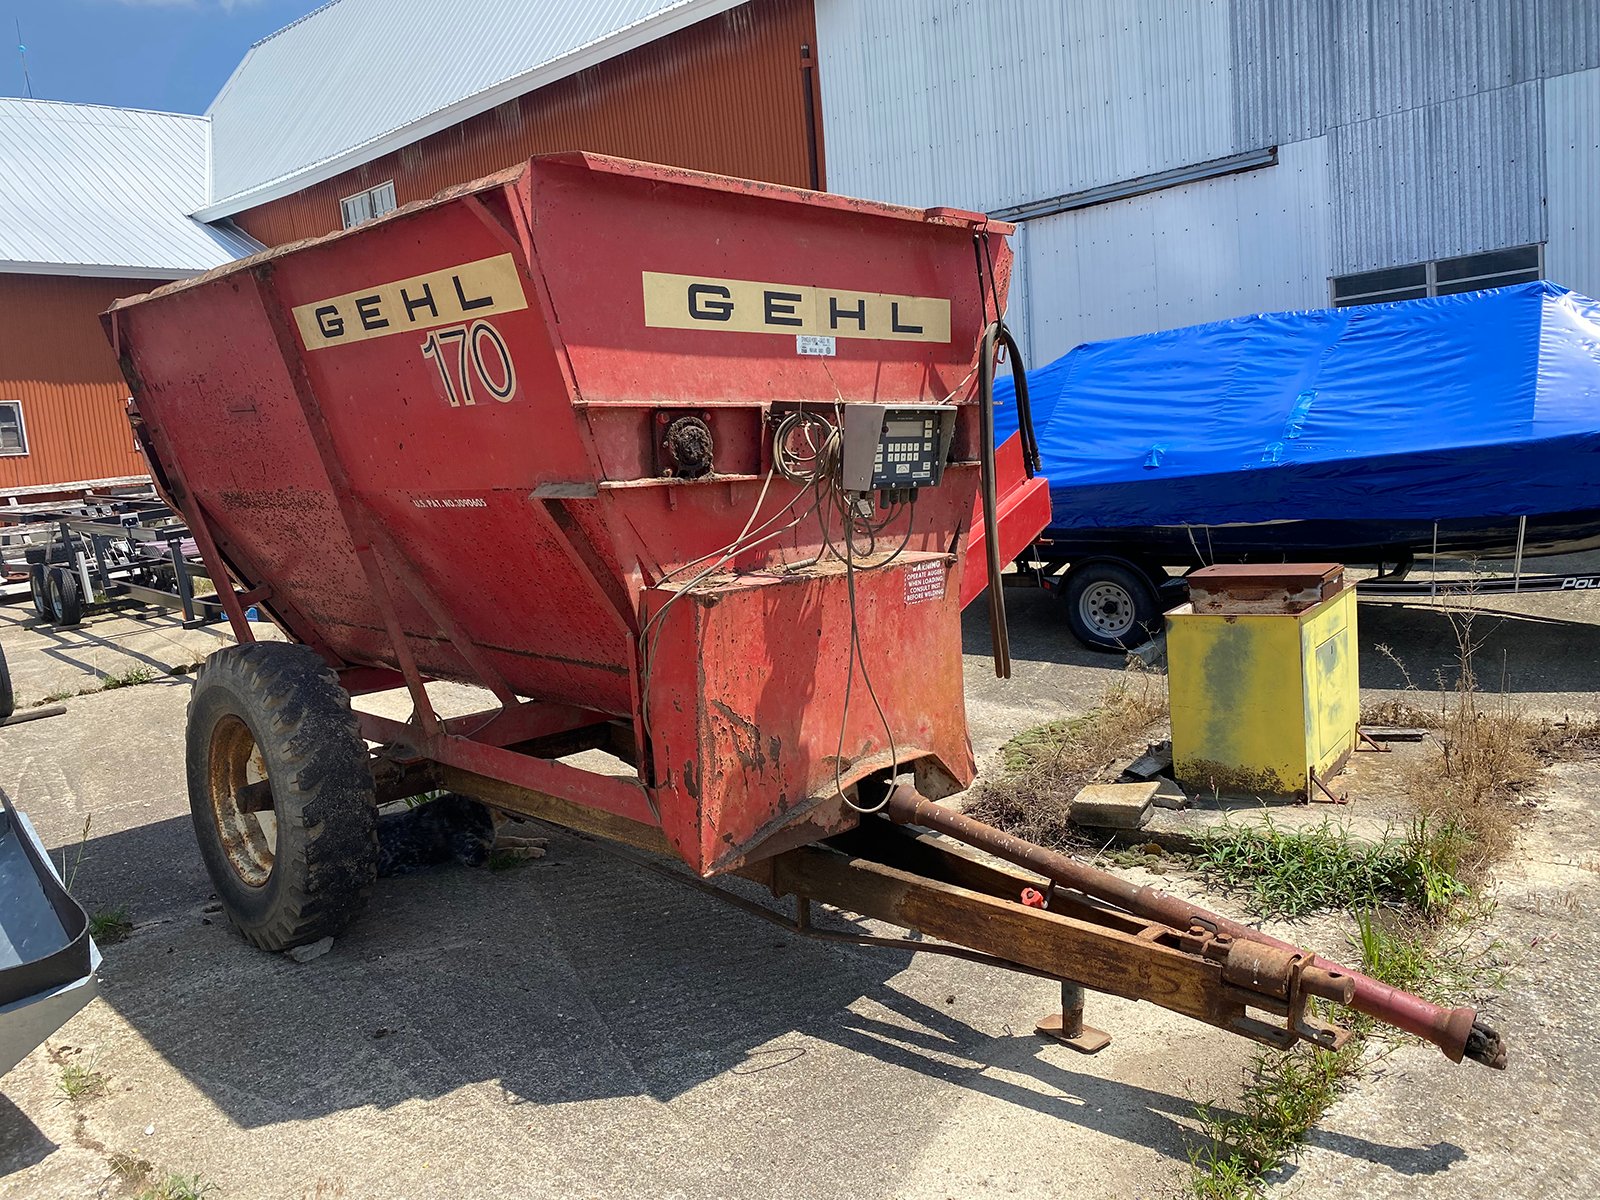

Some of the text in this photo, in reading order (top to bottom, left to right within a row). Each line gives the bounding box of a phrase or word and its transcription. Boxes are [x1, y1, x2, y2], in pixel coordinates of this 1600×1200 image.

[315, 275, 494, 338] GEHL
[687, 283, 923, 334] GEHL
[420, 319, 517, 407] 170
[906, 572, 926, 580] OPERATE
[922, 576, 943, 584] LOADING
[910, 585, 930, 593] CONSULT
[1560, 577, 1600, 589] POL
[906, 589, 944, 601] BEFORE WELDING
